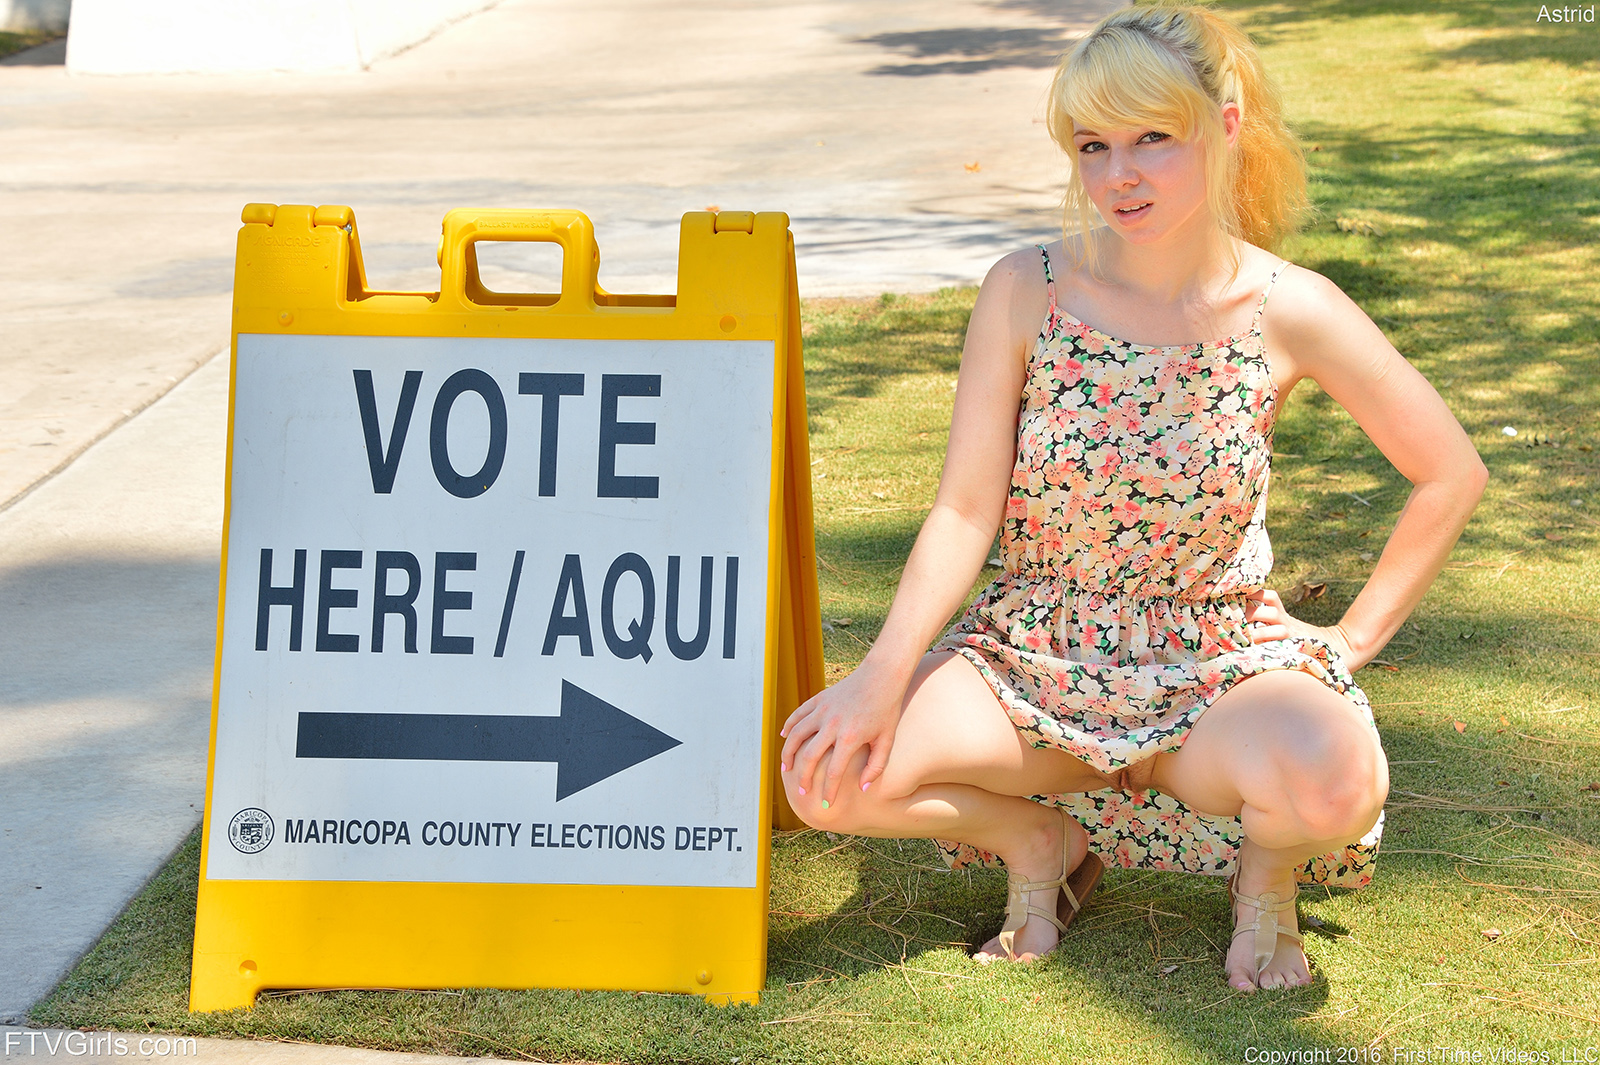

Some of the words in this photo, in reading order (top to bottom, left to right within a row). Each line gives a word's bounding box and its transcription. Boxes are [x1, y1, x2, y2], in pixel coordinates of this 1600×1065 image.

[530, 222, 551, 230] SAND
[353, 369, 662, 499] VOTE
[255, 548, 478, 655] HERE
[541, 552, 739, 665] AQUI
[234, 810, 270, 825] MARICOPA
[235, 840, 266, 852] COUNTY
[284, 819, 411, 846] MARICOPA
[421, 820, 522, 848] COUNTY
[530, 823, 665, 851] ELECTIONS
[674, 826, 742, 852] DEPT.
